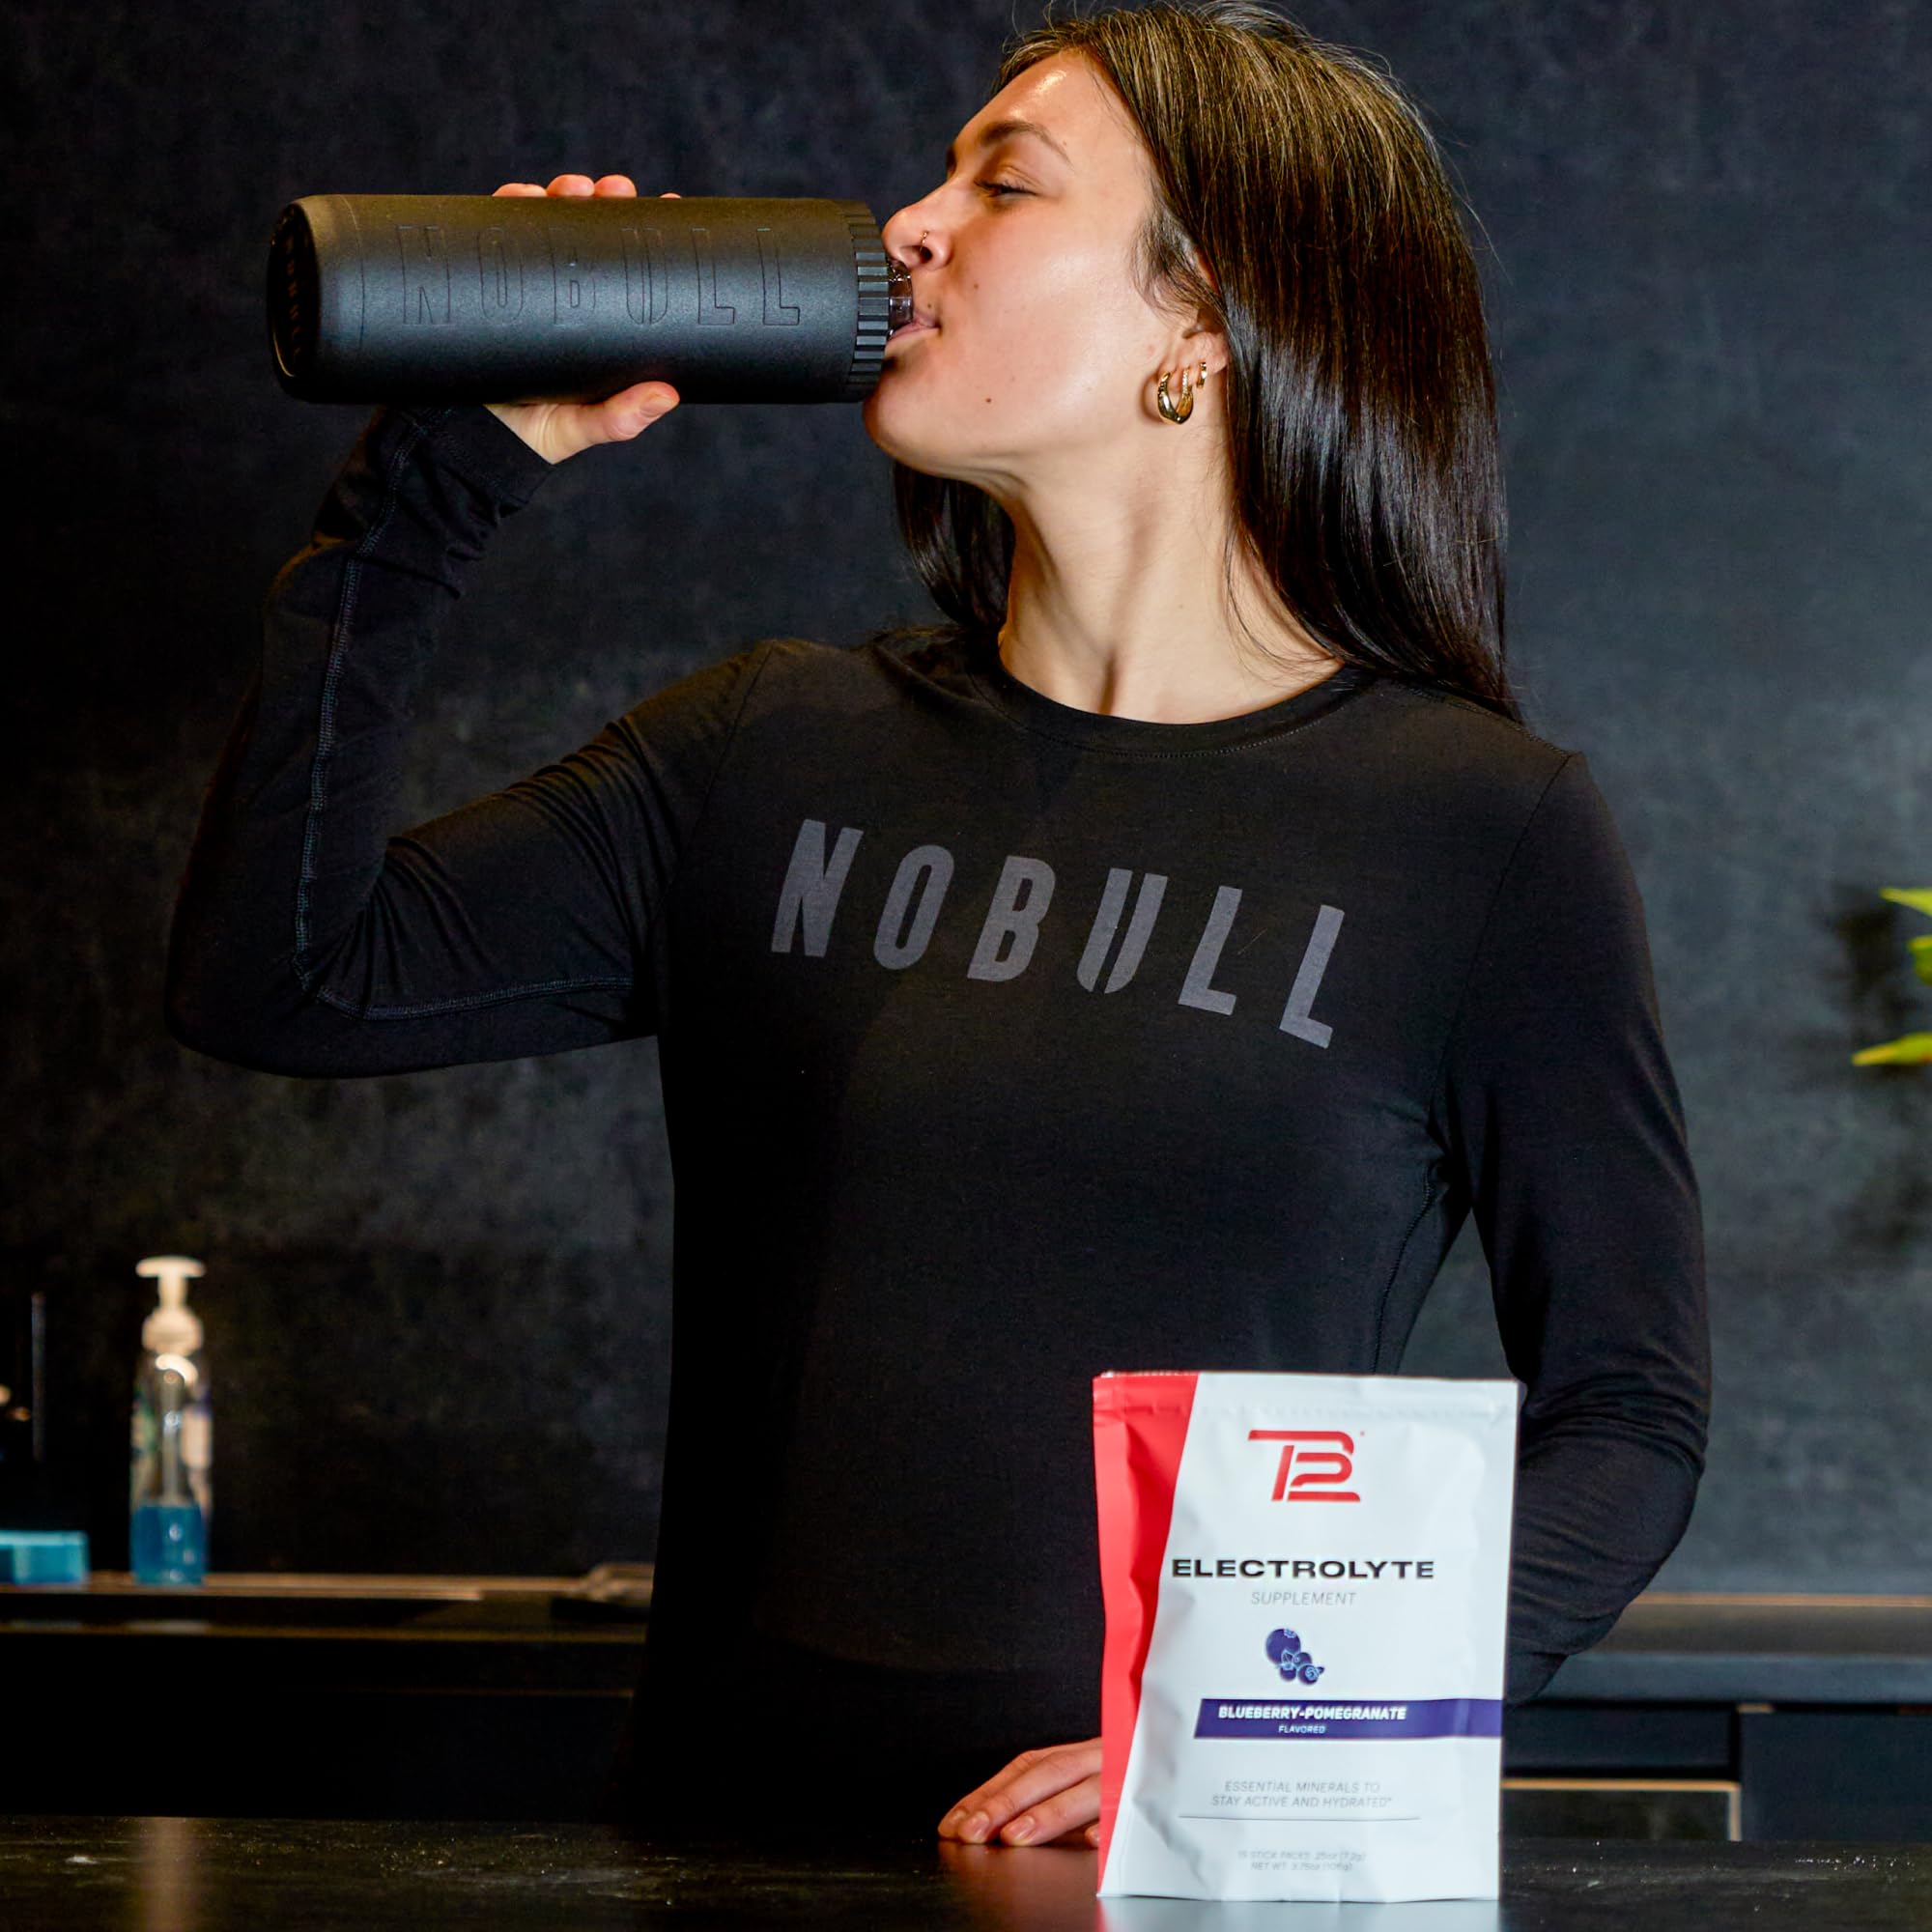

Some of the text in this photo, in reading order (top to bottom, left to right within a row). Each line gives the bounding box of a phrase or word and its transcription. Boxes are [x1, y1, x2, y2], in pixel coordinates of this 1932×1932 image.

[395, 225, 801, 327] NOBULL
[771, 819, 1345, 1049] NOBULL
[1172, 1559, 1435, 1579] ELECTROLYTE
[1251, 1591, 1357, 1605] SUPPLEMENT
[1218, 1705, 1406, 1720] BLUEBERRY-POMEGRANATE
[1278, 1724, 1326, 1734] FLAVORED
[1225, 1780, 1381, 1794] ESSENTIAL MINERALS TO
[1211, 1795, 1241, 1806] STAY
[1244, 1796, 1288, 1807] ACTIVE
[1292, 1797, 1320, 1807] AND
